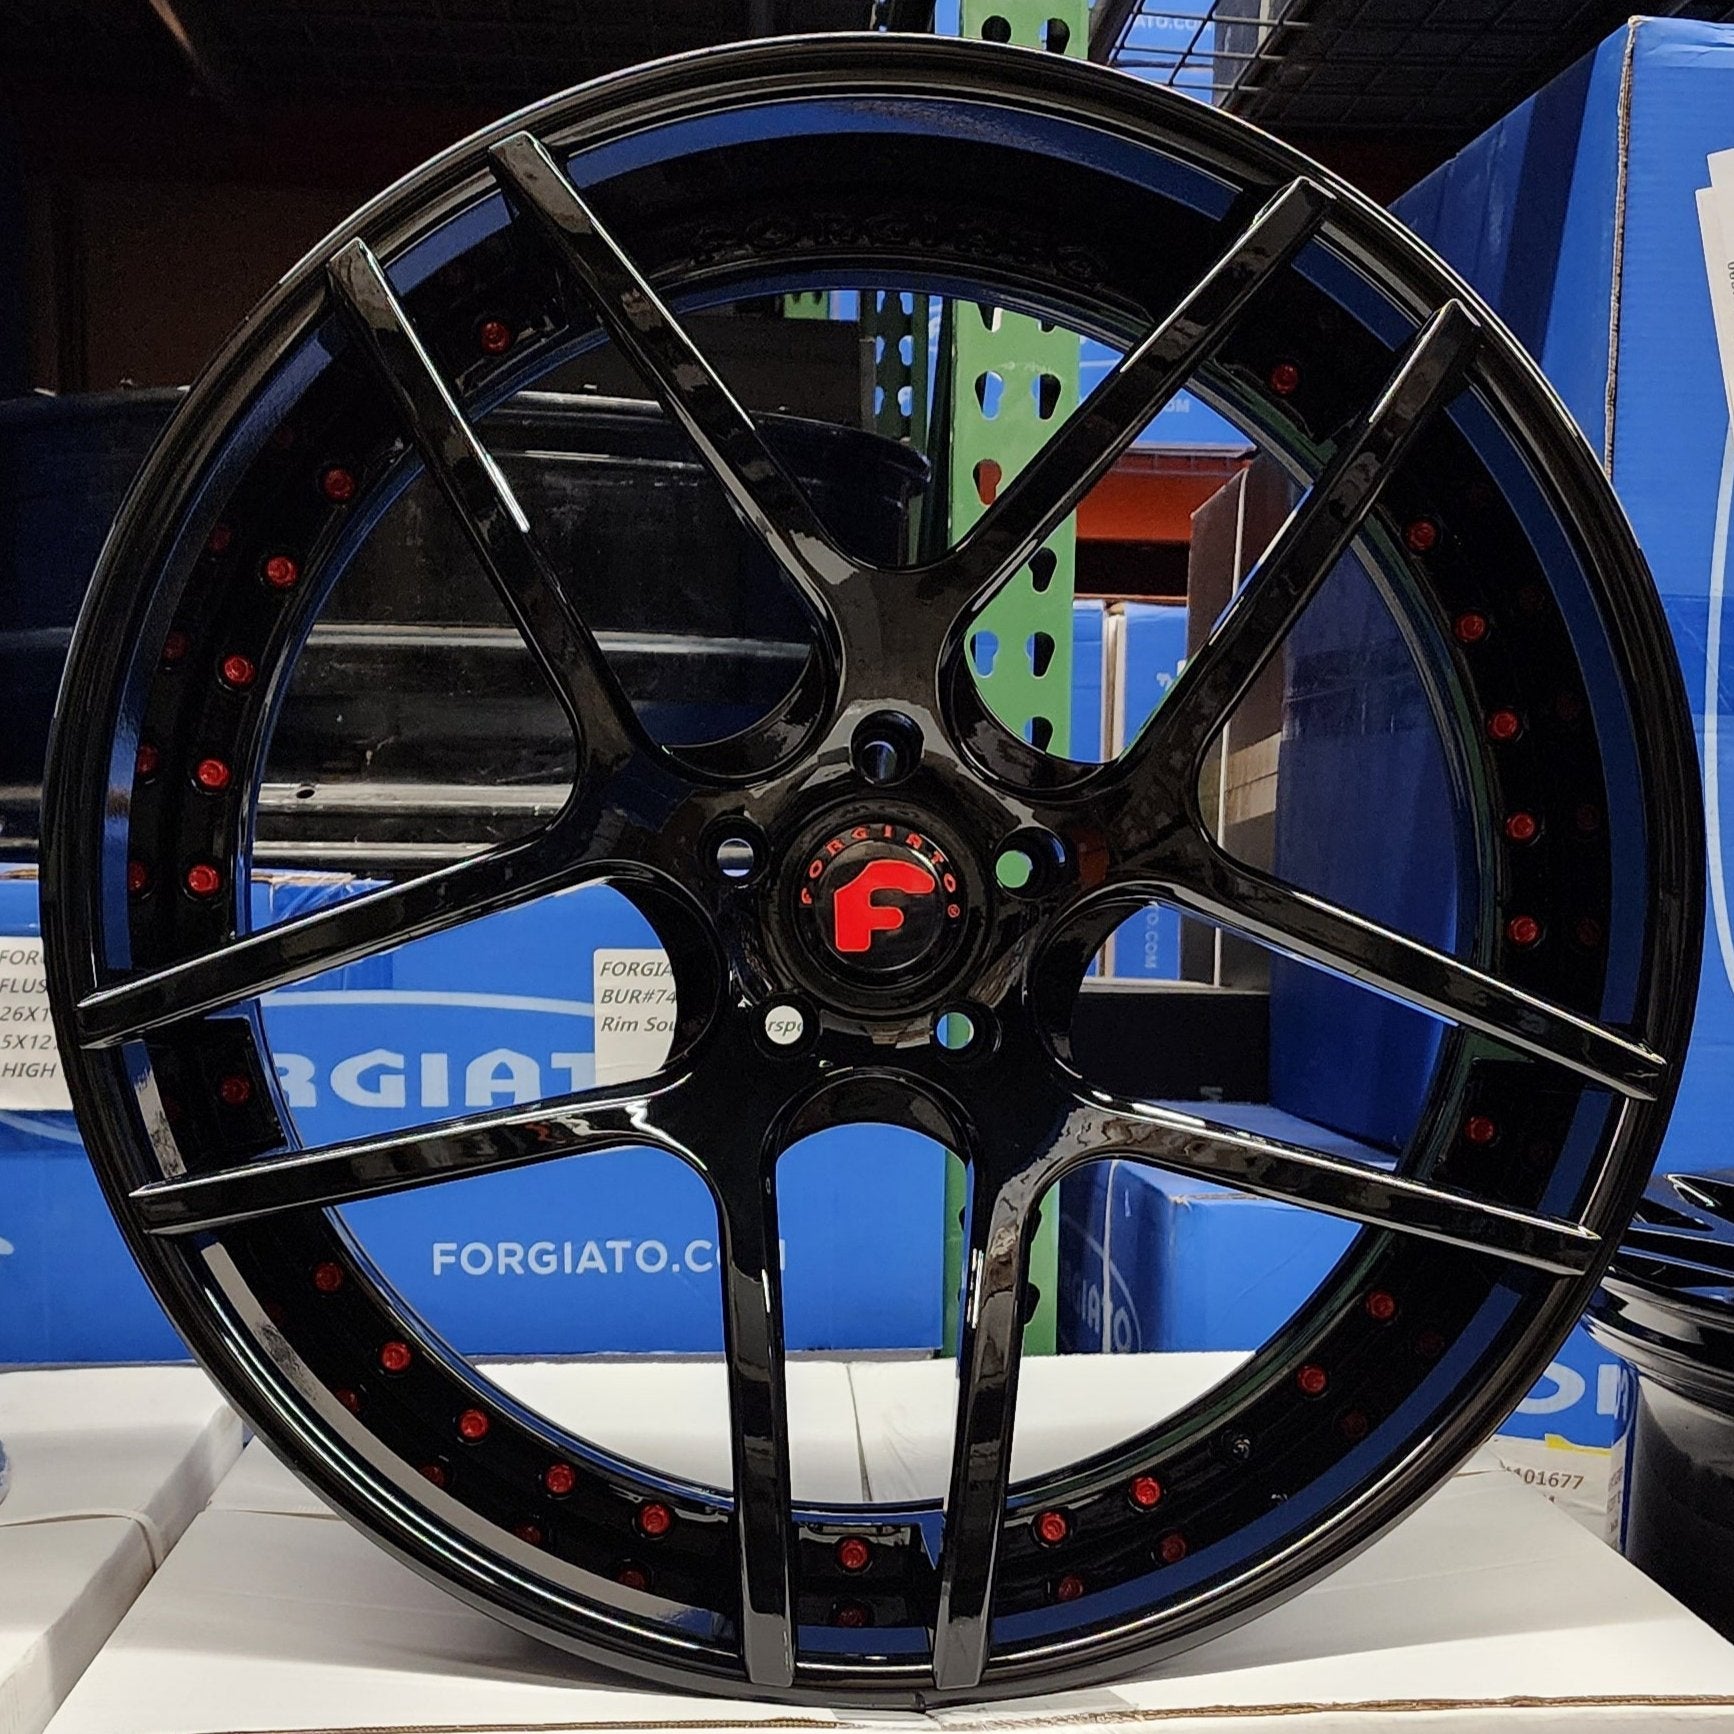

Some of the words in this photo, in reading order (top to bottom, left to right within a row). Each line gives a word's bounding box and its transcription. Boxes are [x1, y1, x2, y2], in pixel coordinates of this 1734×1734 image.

[834, 859, 936, 952] F
[1144, 902, 1159, 969] O.COM
[0, 950, 44, 965] FOR
[601, 1016, 638, 1032] Rim
[1, 1034, 57, 1050] 5X12
[2, 1062, 57, 1078] HIGH
